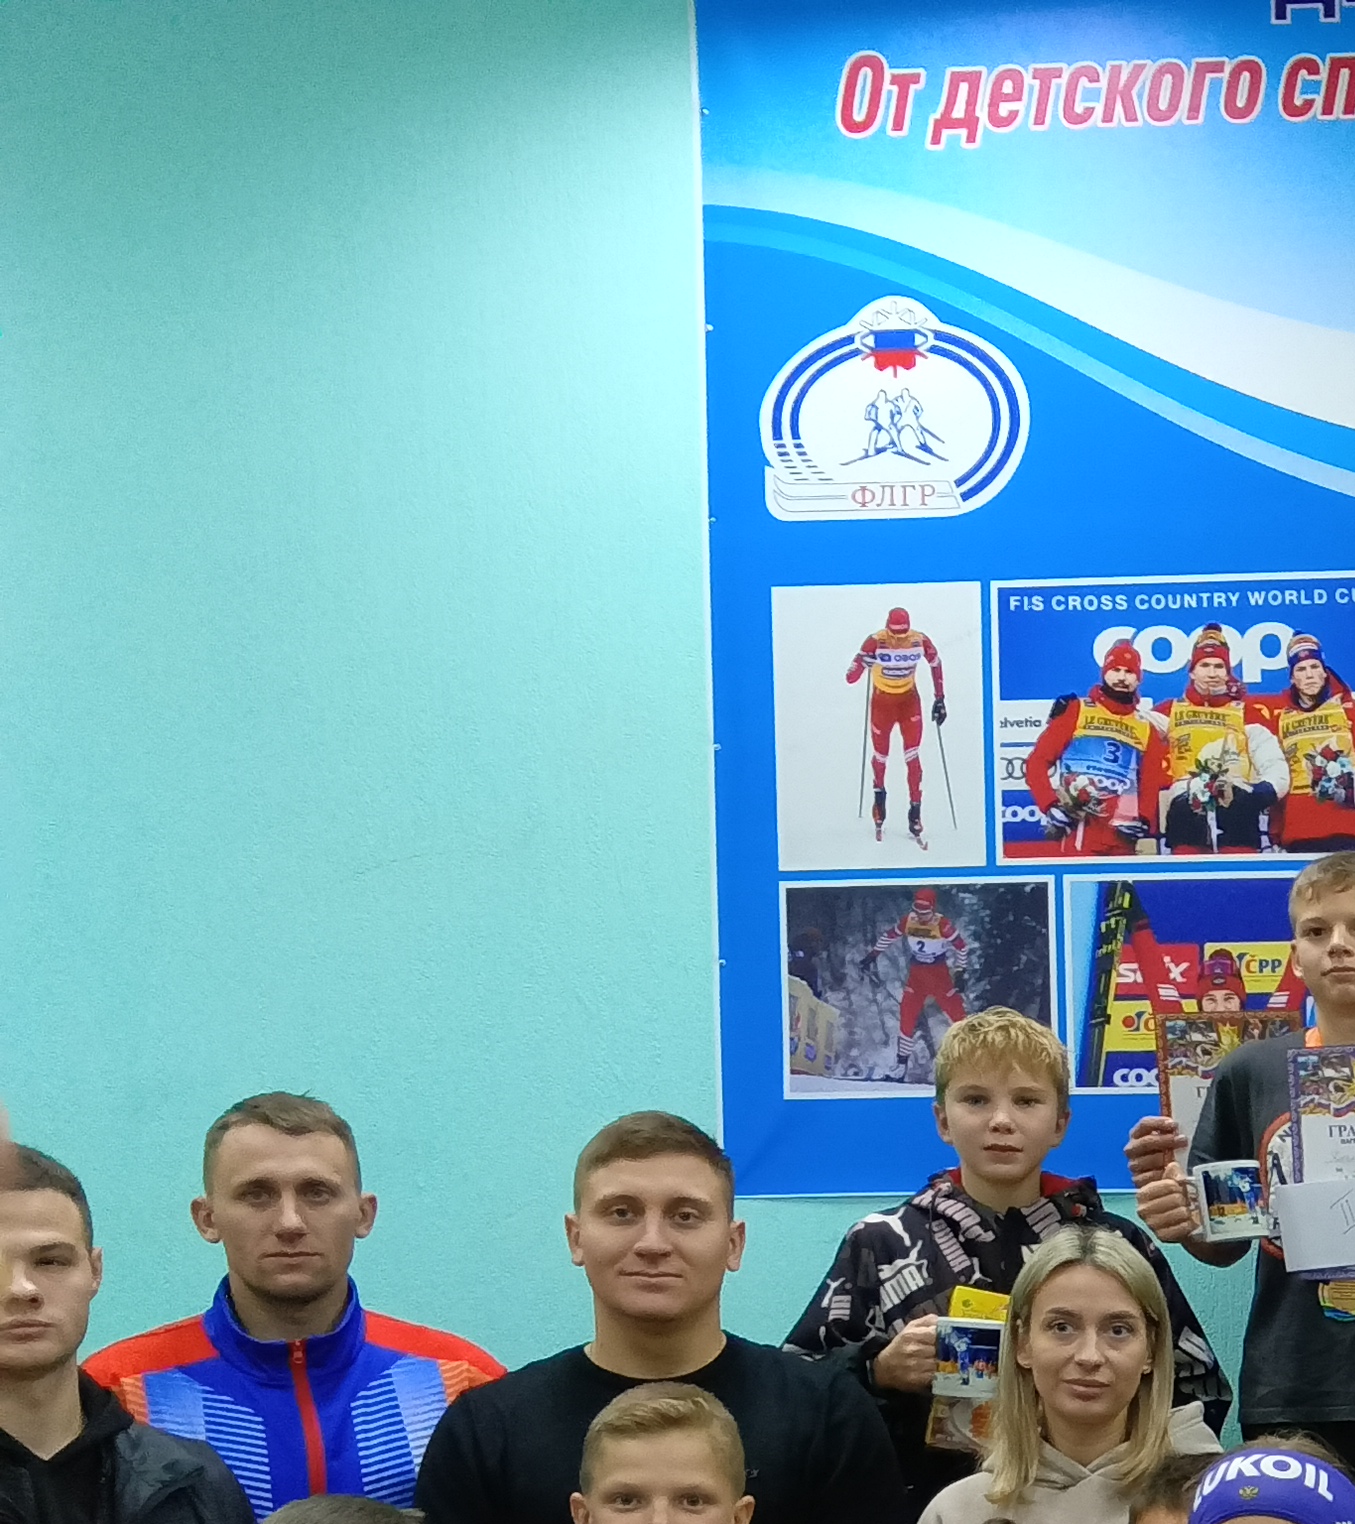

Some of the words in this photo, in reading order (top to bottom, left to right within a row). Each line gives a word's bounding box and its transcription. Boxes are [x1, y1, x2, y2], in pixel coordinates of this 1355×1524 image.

[839, 53, 913, 136] От
[929, 57, 1263, 147] детского
[851, 483, 937, 512] ФЛГР
[1009, 595, 1045, 612] FIS
[1052, 594, 1128, 611] CROSS
[1135, 591, 1240, 610] COUNTRY
[1247, 588, 1328, 606] WORLD
[1103, 742, 1121, 764] 3
[916, 940, 926, 953] 2
[1245, 954, 1282, 974] ČPP
